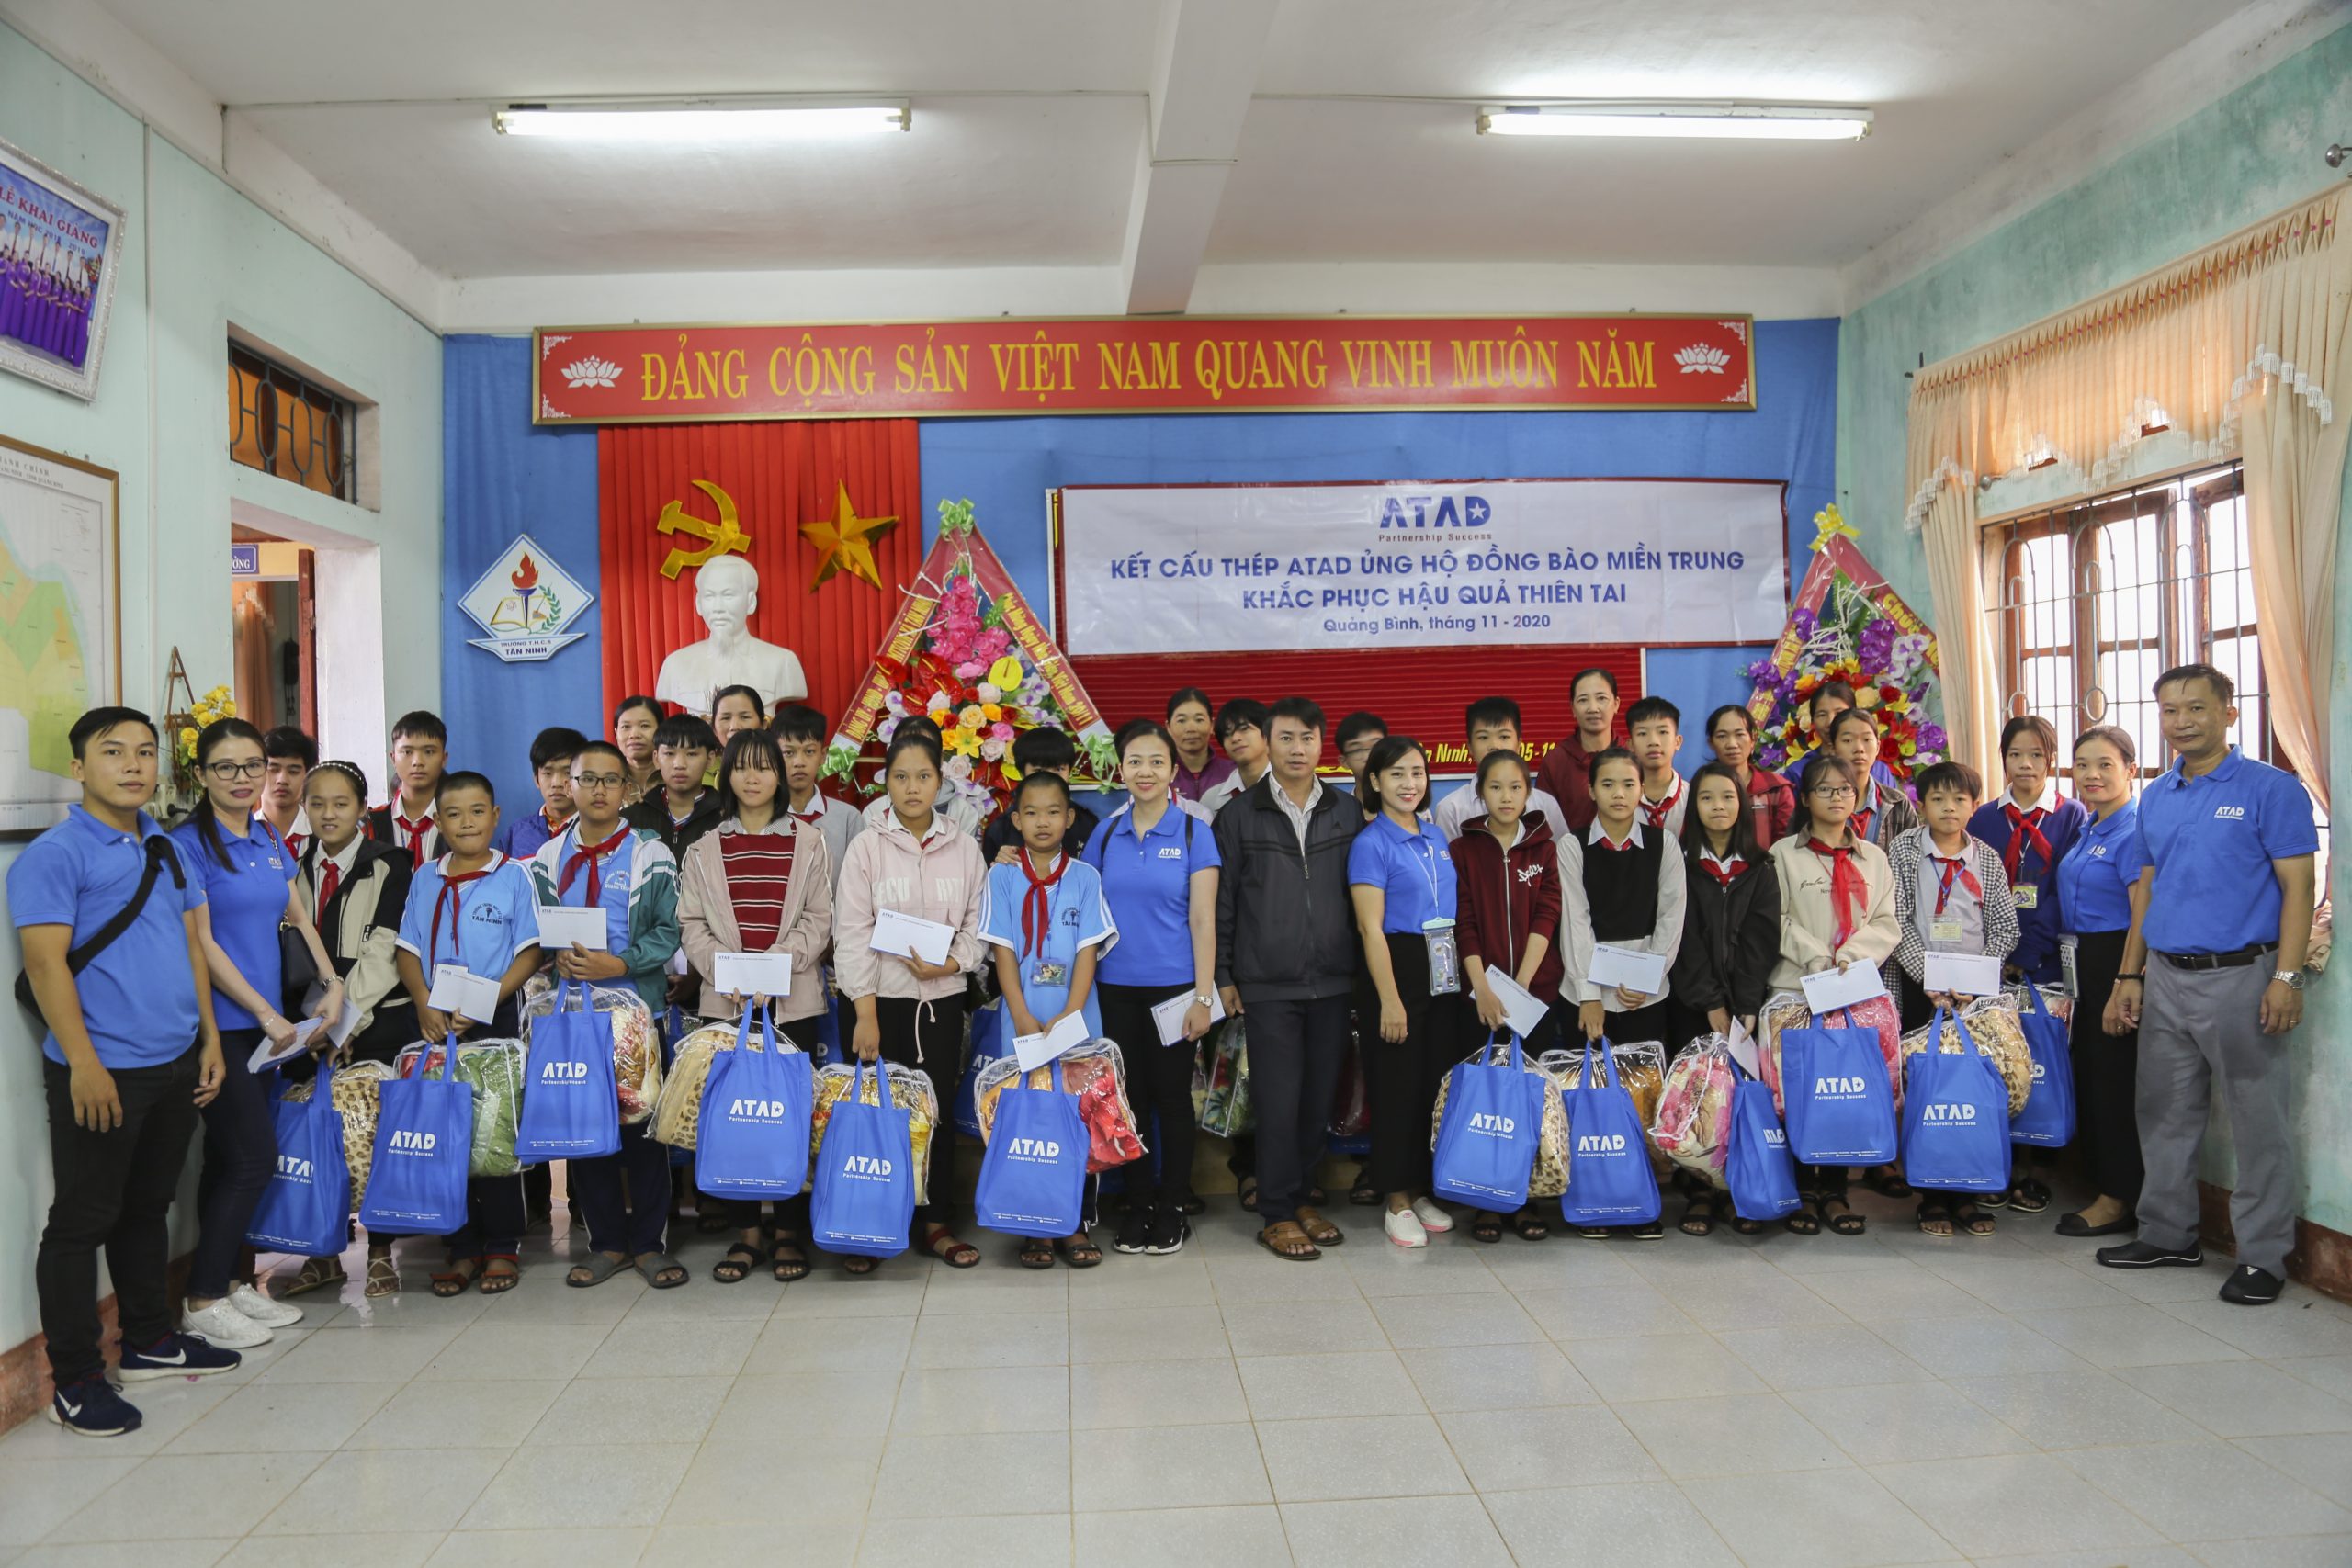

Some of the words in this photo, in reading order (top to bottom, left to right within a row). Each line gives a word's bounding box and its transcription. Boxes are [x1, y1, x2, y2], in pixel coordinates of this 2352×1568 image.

[18, 197, 53, 225] KHAI
[641, 333, 749, 400] ĐẢNG
[769, 333, 876, 408] CỘNG
[895, 328, 969, 393] SẢN
[989, 330, 1080, 402] VIỆT
[1097, 341, 1182, 390] NAM
[1194, 339, 1328, 400] QUANG
[1340, 340, 1435, 389] VINH
[1451, 325, 1559, 389] MUÔN
[1576, 328, 1657, 389] NĂM
[1379, 496, 1492, 529] ATAD
[1379, 533, 1442, 543] Partnership
[1448, 532, 1492, 542] Success
[1111, 551, 1151, 579] KẾT
[1159, 549, 1213, 579] CẤU
[1221, 553, 1279, 577] THÉP
[1287, 556, 1351, 576] ATAD
[1361, 549, 1413, 574] ỦNG
[1421, 549, 1458, 578] HỘ
[1467, 543, 1540, 572] ĐỒNG
[1548, 547, 1599, 570] BÀO
[1607, 542, 1662, 570] MIỀN
[1668, 551, 1745, 570] TRUNG
[1243, 581, 1314, 609] KHẮC
[1322, 588, 1389, 613] PHỤC
[1398, 582, 1449, 611] HẬU
[1458, 579, 1510, 604] QUẢ
[1518, 580, 1583, 604] THIÊN
[1590, 584, 1626, 603] TAI
[1323, 618, 1378, 635] Quảng
[1385, 615, 1424, 632] Bình,
[1429, 615, 1476, 632] tháng
[1481, 616, 1498, 628] 11
[1513, 615, 1551, 628] 2020
[505, 647, 522, 655] TÂN
[525, 647, 547, 655] NINH
[2215, 806, 2245, 816] ATAD
[1159, 847, 1182, 856] ATAD
[542, 1061, 588, 1078] ATAD
[1815, 1077, 1865, 1094] ATAD
[729, 1099, 785, 1118] ATAD
[1923, 1104, 1976, 1120] ATAD
[1470, 1112, 1515, 1134] ATAD
[390, 1130, 436, 1150] ATAD
[1009, 1137, 1060, 1157] ATAD
[1578, 1134, 1625, 1151] ATAD
[277, 1155, 313, 1178] ATA
[844, 1156, 891, 1176] ATAD
